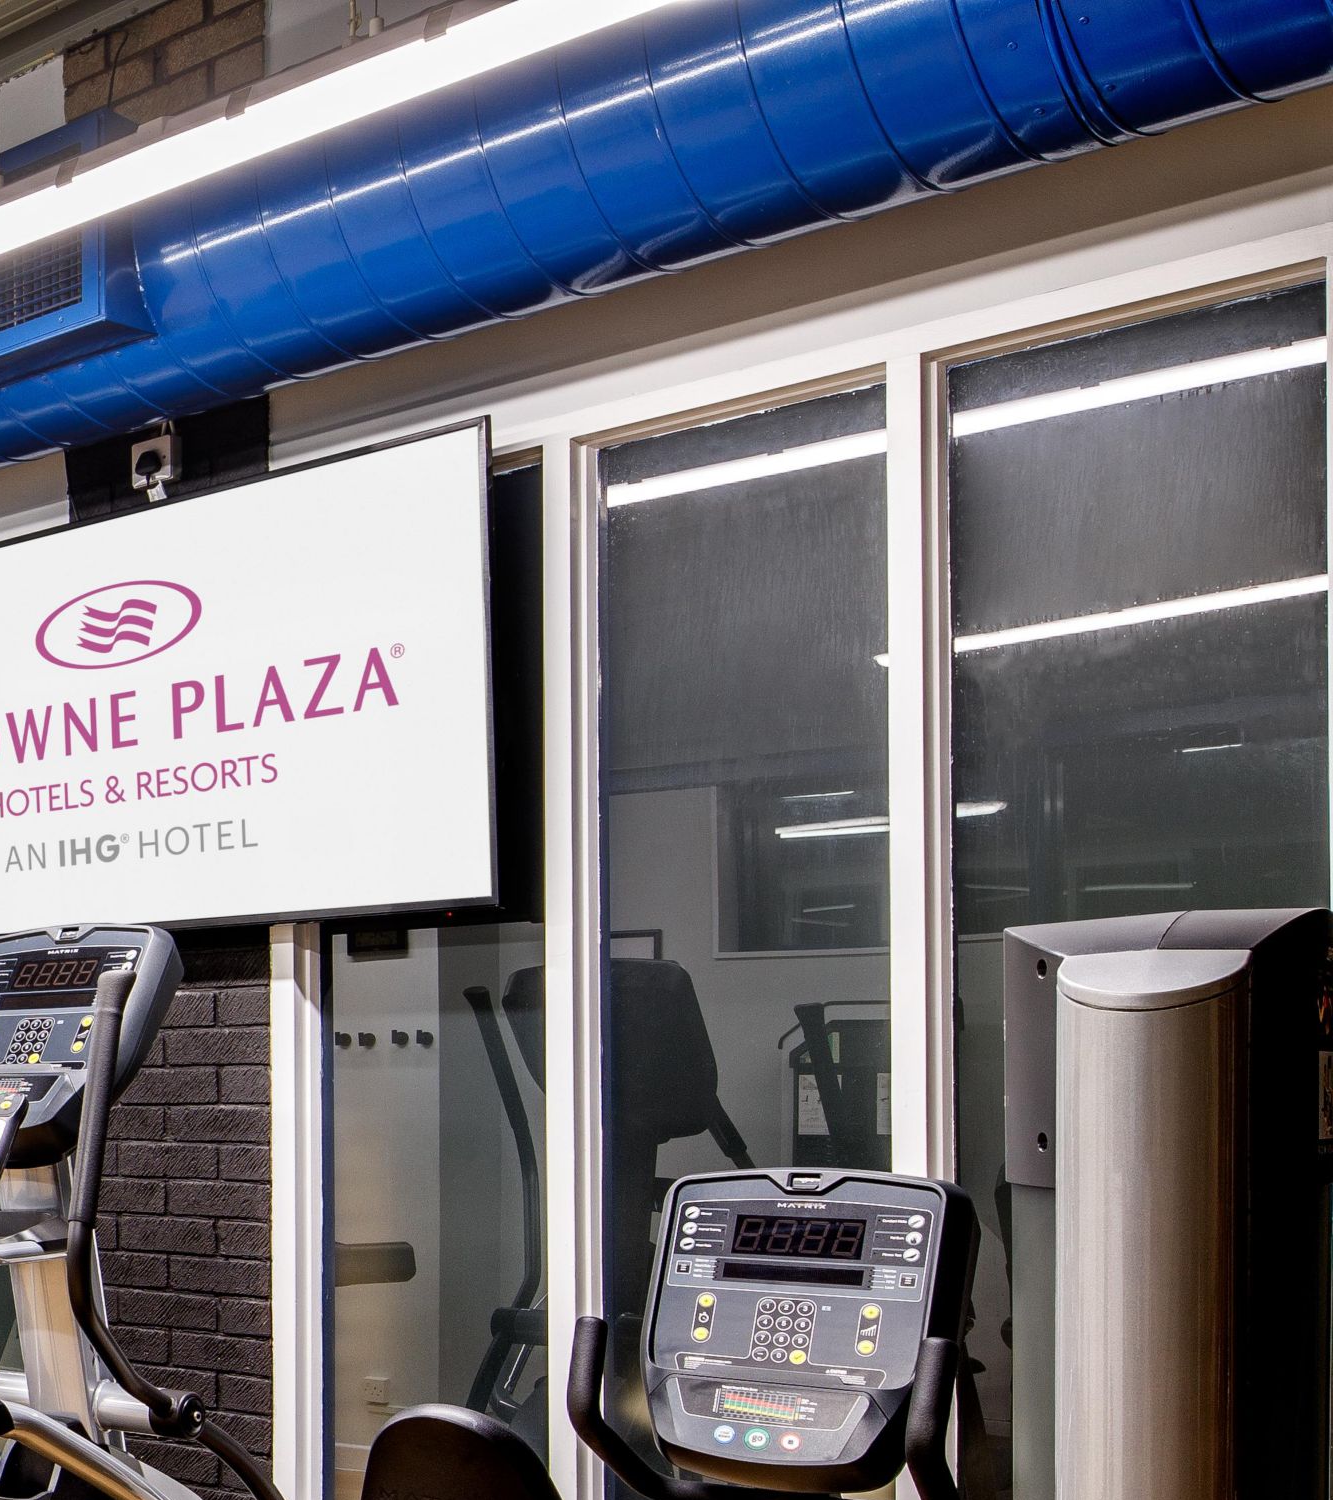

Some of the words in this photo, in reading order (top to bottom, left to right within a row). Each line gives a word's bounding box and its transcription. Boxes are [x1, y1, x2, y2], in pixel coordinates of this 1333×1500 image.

[104, 772, 127, 804] &
[136, 753, 279, 800] RESORTS
[5, 841, 47, 874] AN
[138, 819, 259, 860] HOTEL
[776, 1202, 827, 1210] MATRIX
[751, 1434, 763, 1443] go
